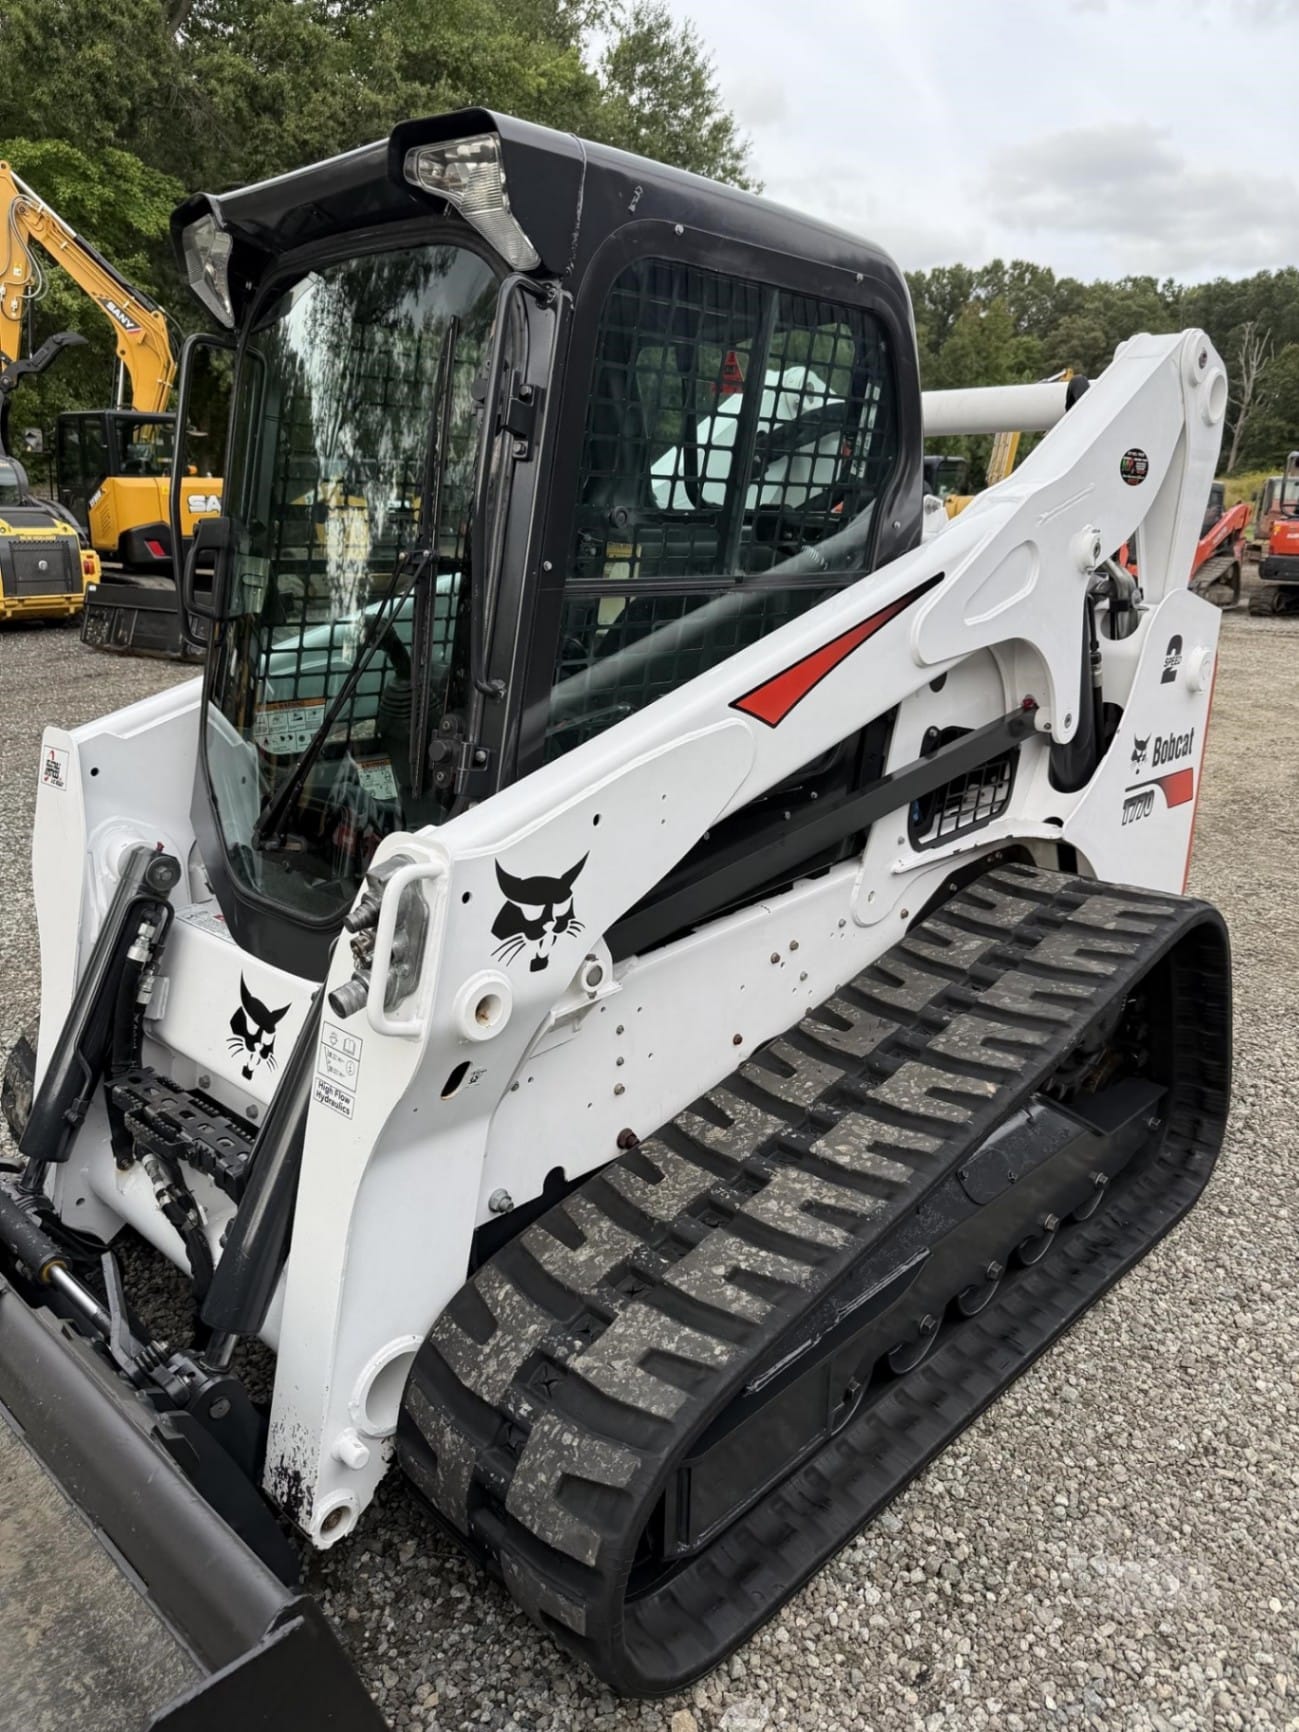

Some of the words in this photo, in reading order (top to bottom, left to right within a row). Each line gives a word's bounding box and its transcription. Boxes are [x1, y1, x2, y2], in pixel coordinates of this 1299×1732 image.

[105, 301, 135, 328] SANY
[187, 494, 222, 513] SA
[1160, 634, 1183, 684] 2
[1151, 727, 1194, 768] Bobcat
[316, 1089, 350, 1116] Hydraulics
[318, 1079, 334, 1096] High
[334, 1088, 351, 1105] Flow
